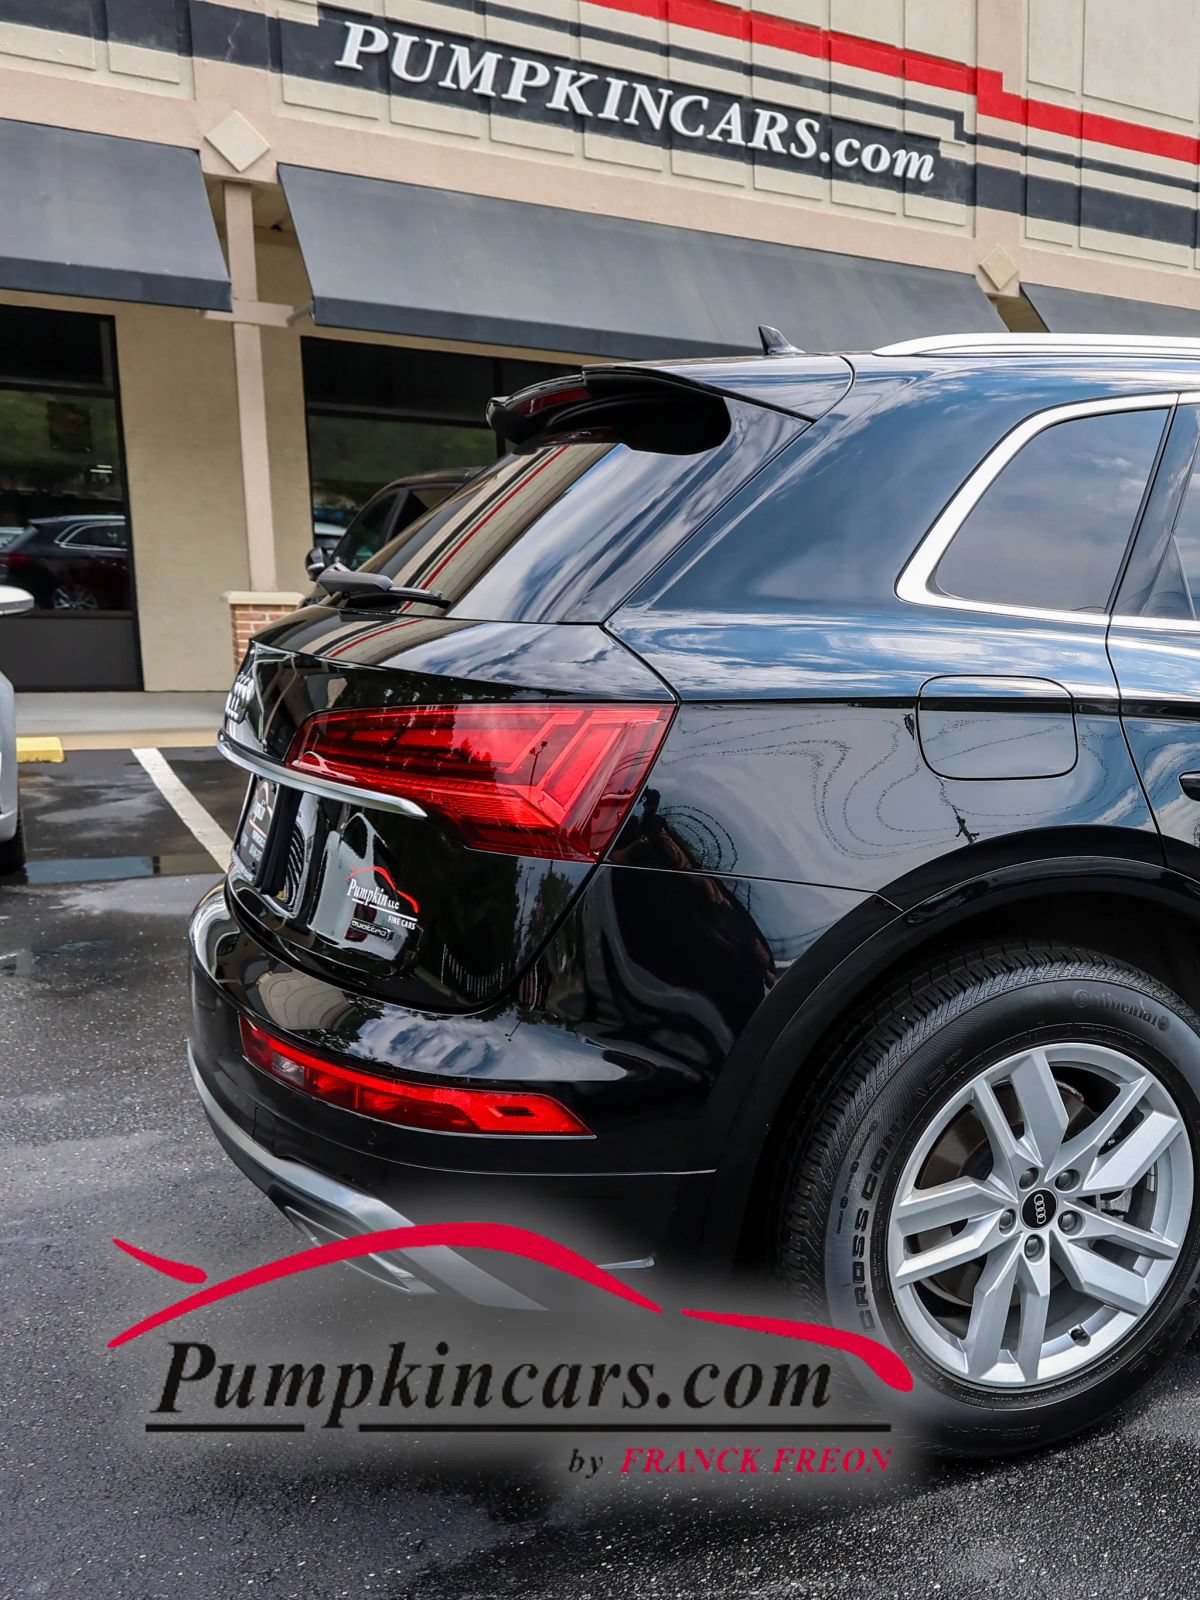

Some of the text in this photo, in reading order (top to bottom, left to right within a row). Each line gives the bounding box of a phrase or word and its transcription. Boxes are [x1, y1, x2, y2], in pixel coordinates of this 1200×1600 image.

[334, 21, 935, 183] PUMPKINCARS.com
[346, 878, 400, 910] Pumpkin LLC
[388, 915, 416, 931] FINE CARS
[852, 1206, 875, 1332] CROSS
